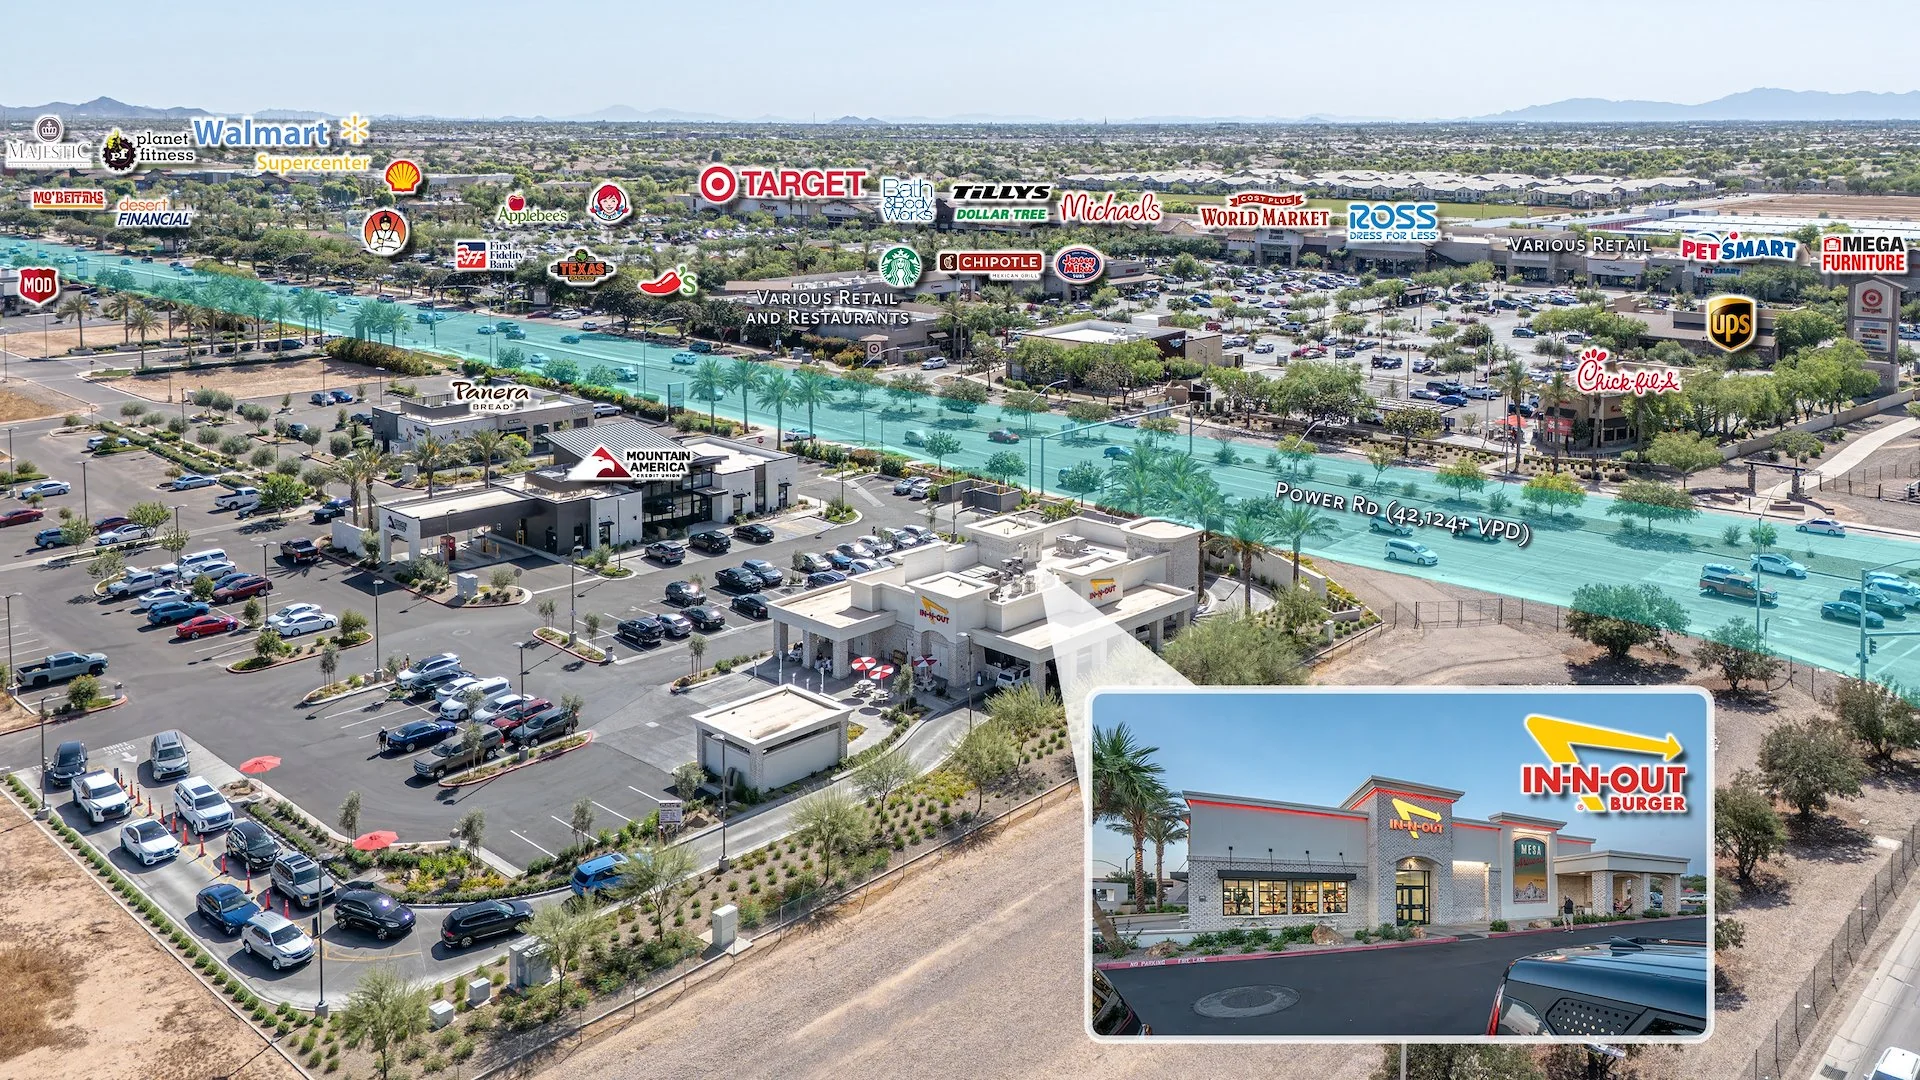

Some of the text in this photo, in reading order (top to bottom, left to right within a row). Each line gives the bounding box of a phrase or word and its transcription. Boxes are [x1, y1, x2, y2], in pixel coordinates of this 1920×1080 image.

[919, 609, 950, 624] IN-N-OUT
[1390, 819, 1443, 834] IN-N-OUT
[1521, 844, 1542, 855] MESA
